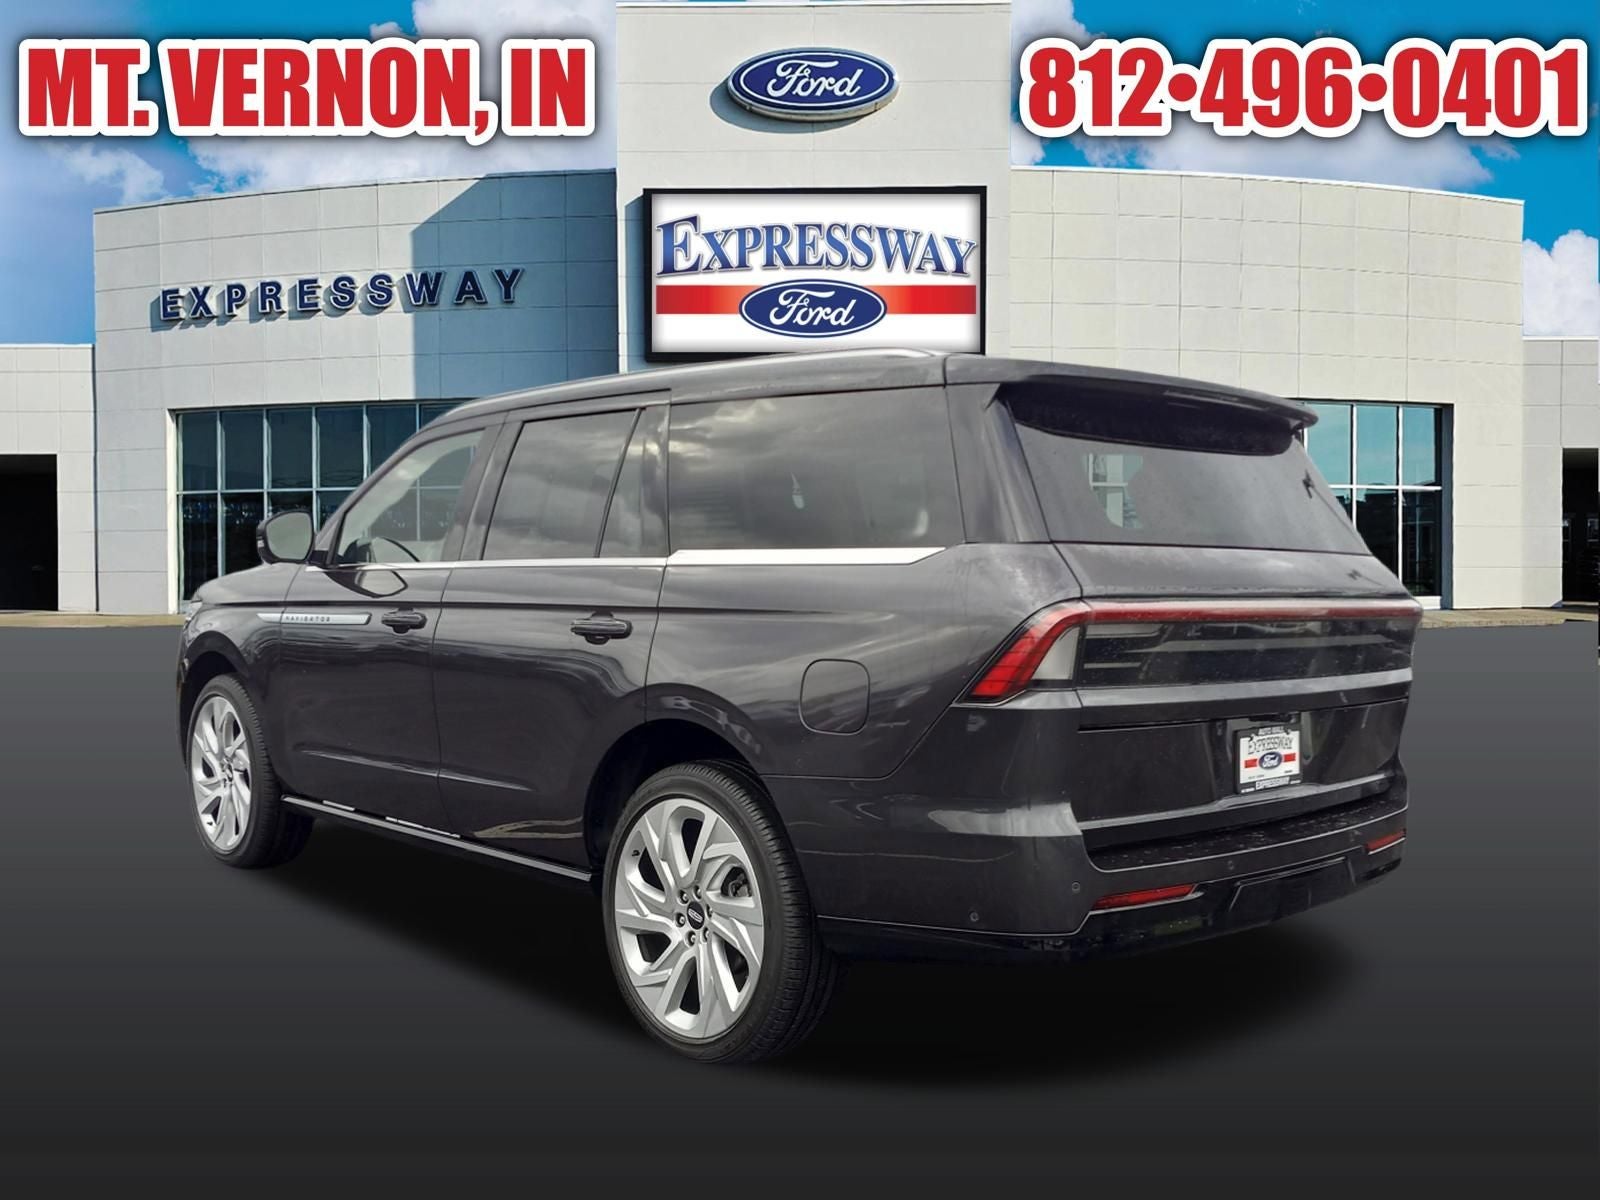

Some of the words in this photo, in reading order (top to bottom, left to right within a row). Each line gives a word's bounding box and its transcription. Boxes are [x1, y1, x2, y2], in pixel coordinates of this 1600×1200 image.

[766, 59, 864, 97] Ford
[656, 214, 978, 277] EXPRESSWAY
[159, 267, 526, 322] EXPRESSWAY
[769, 288, 857, 326] Ford
[1262, 754, 1279, 768] Ford
